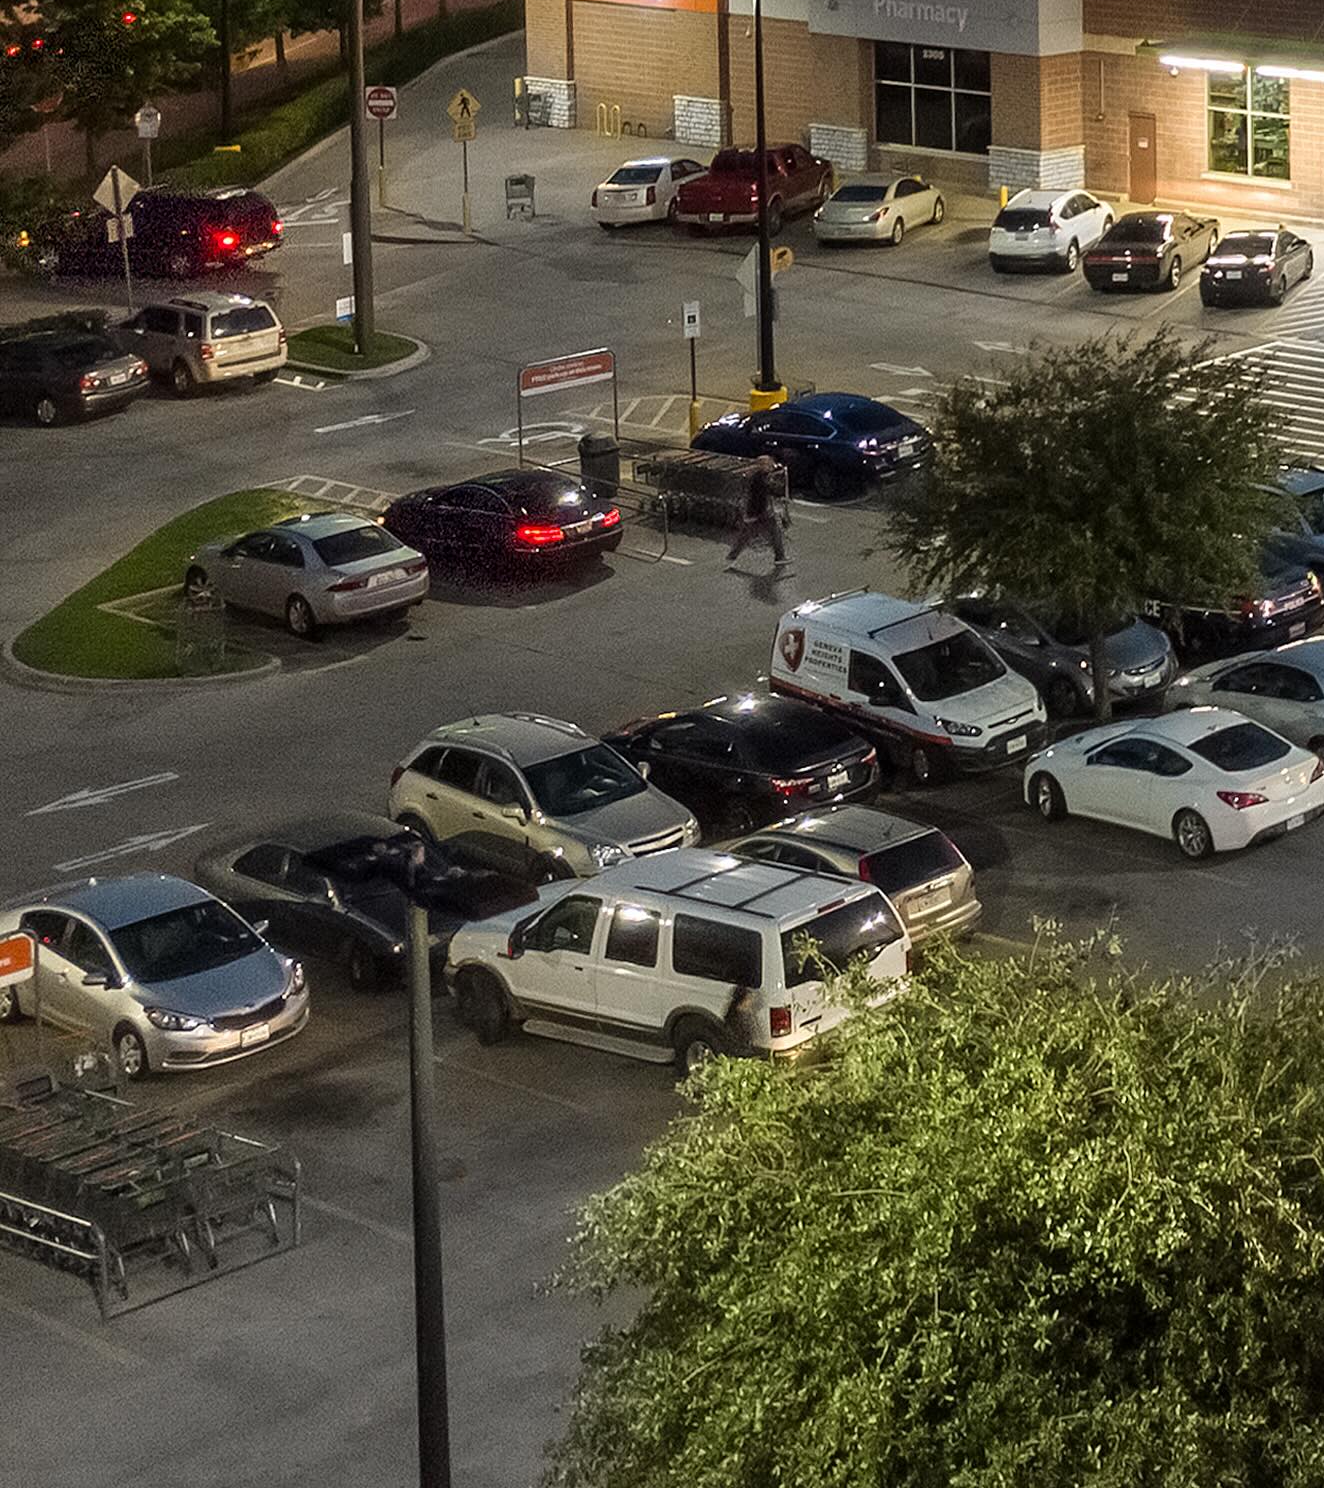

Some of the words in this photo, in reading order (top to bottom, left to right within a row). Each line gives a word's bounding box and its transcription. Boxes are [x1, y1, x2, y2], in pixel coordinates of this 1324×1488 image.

[814, 640, 842, 654] GENEVA
[811, 649, 844, 663] HEIGHTS
[804, 657, 848, 674] PROPERTIES
